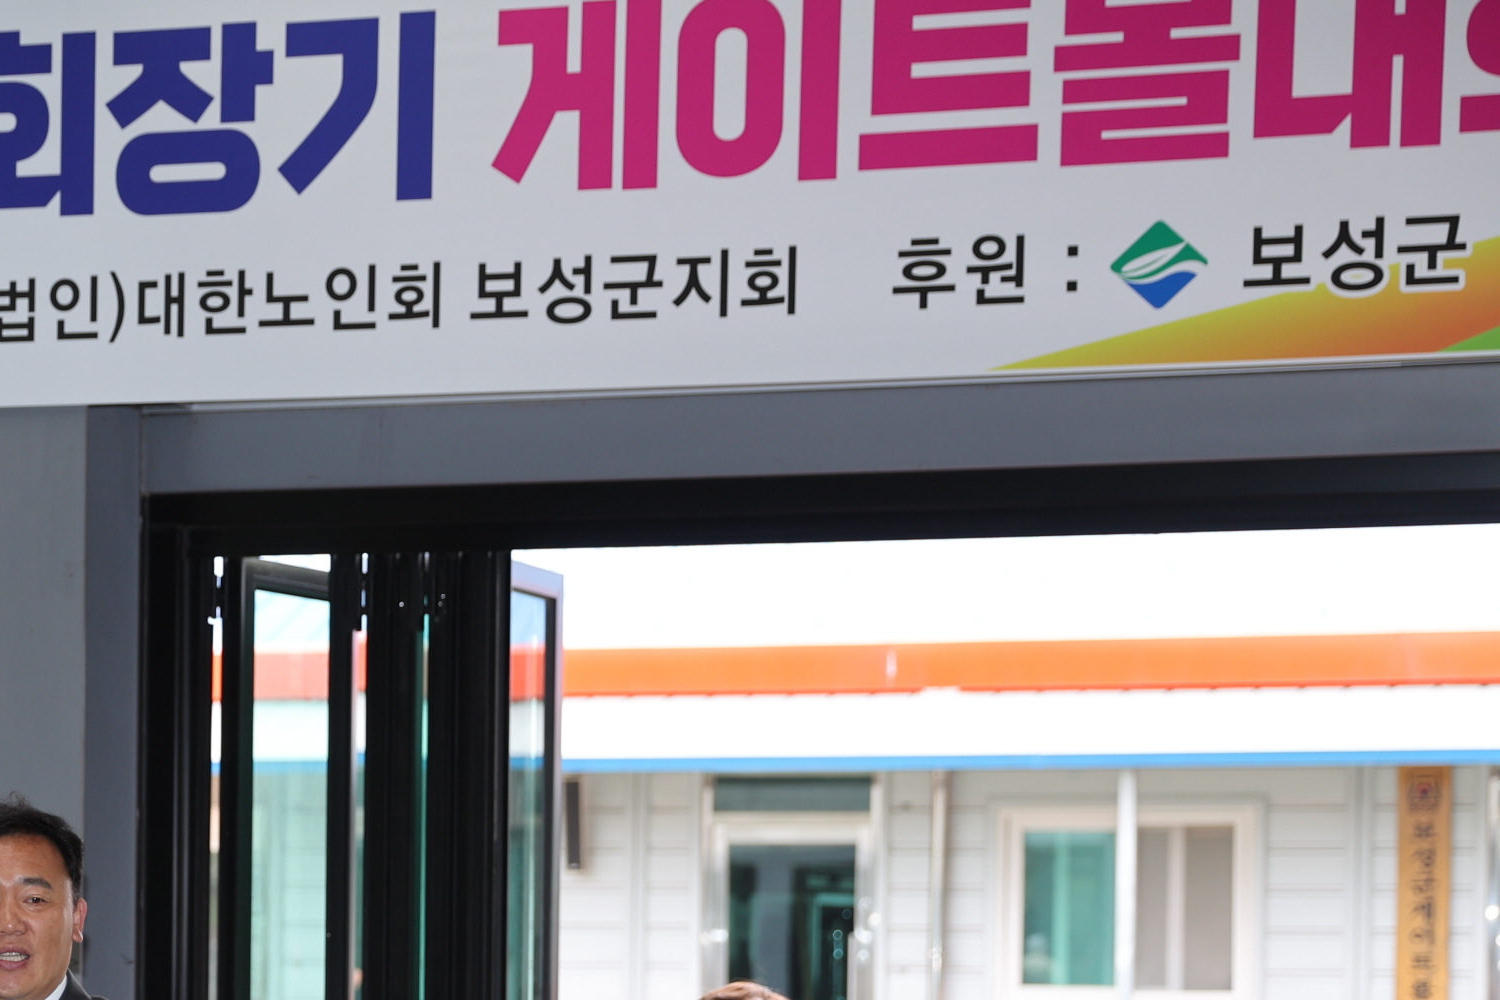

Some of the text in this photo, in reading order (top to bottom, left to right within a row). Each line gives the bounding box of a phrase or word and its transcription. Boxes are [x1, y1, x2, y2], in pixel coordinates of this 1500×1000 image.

[469, 245, 798, 325] 보성군지회
[892, 234, 1026, 310] 후원
[1242, 214, 1468, 291] 보성군
